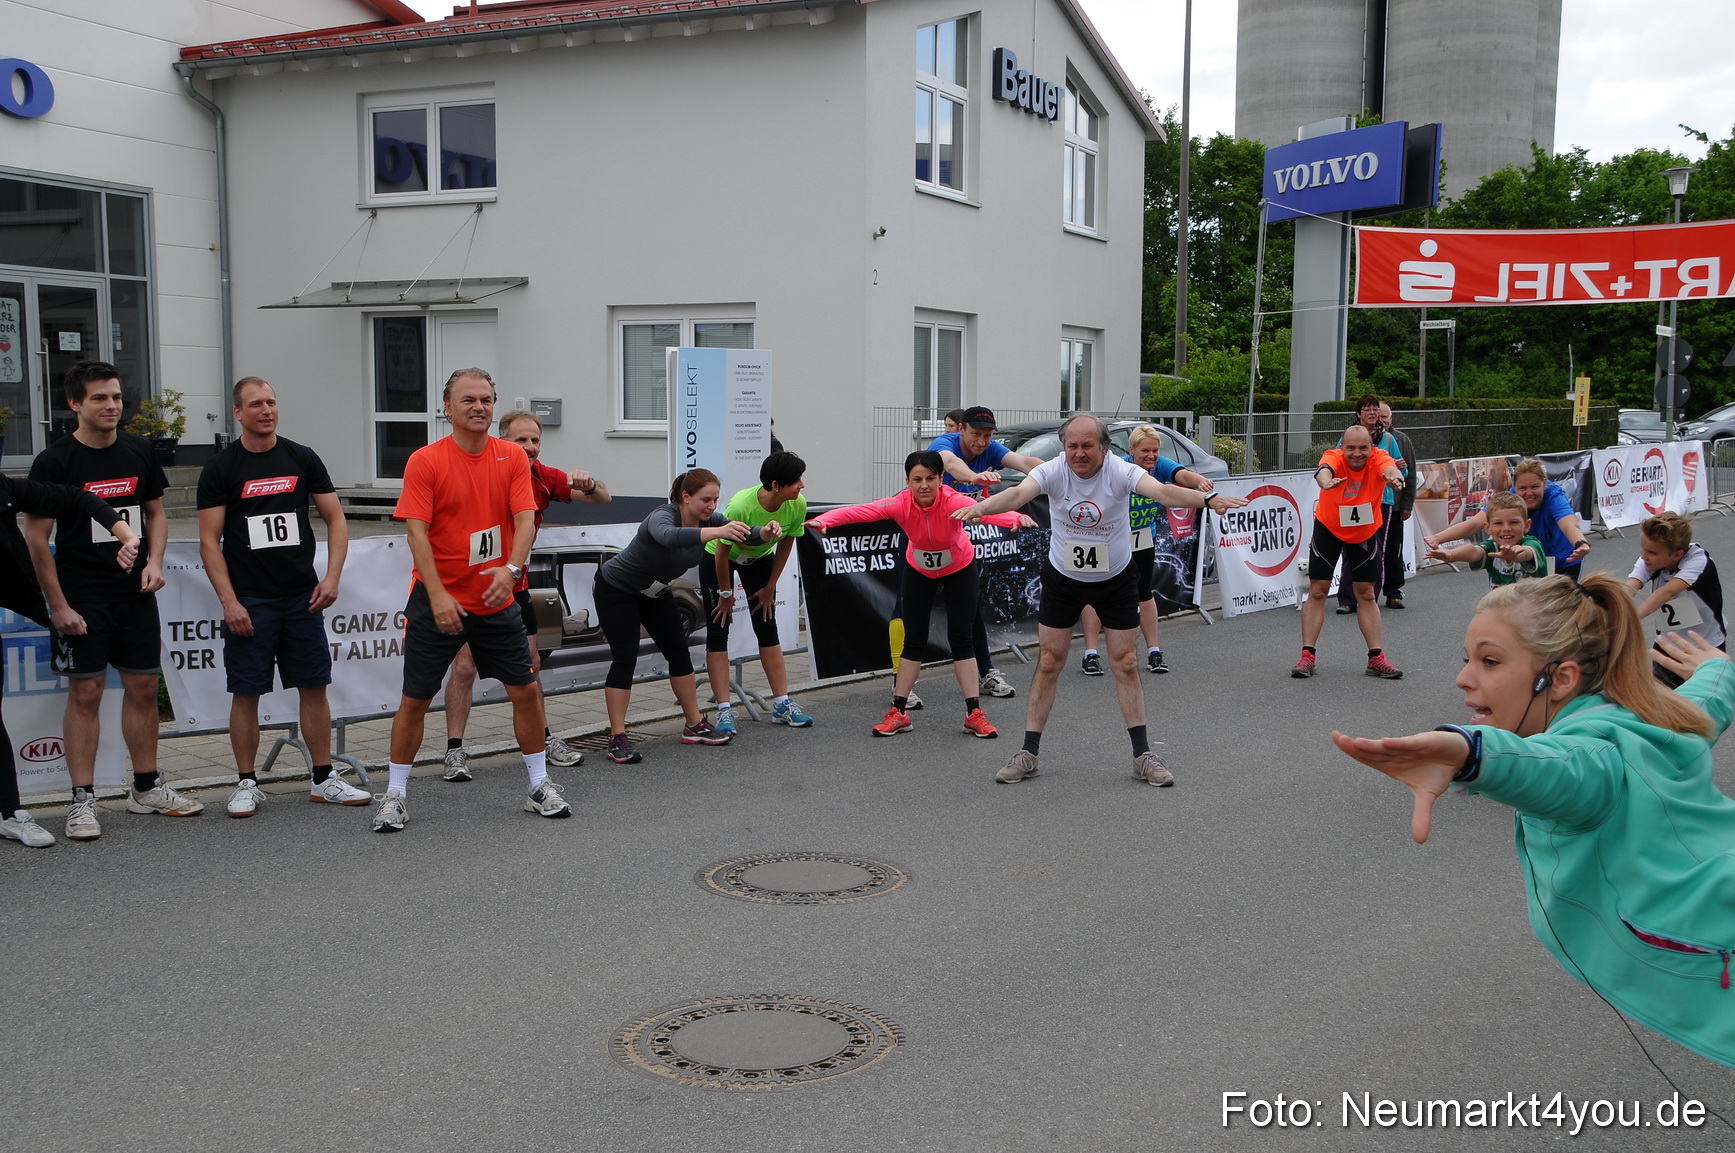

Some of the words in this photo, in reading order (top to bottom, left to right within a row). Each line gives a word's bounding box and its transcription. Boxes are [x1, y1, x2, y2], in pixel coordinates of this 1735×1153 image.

[0, 58, 54, 118] O
[993, 47, 1065, 121] Bauer
[1273, 152, 1379, 194] VOLVO
[873, 269, 878, 286] 2
[686, 363, 698, 469] LVOSELEKT
[1606, 466, 1620, 480] KIA
[88, 481, 133, 496] Franek
[246, 479, 293, 494] Franek
[1131, 495, 1154, 506] ive
[1130, 507, 1157, 518] ove
[1220, 507, 1286, 535] GERHART
[1350, 507, 1360, 523] 4
[262, 515, 288, 542] 16
[964, 525, 1002, 541] SHQAI.
[478, 532, 494, 558] 41
[822, 537, 848, 554] DER
[851, 535, 889, 551] NEUE
[1219, 535, 1252, 548] Autohaus
[1251, 528, 1294, 553] JÄNIG
[825, 557, 866, 575] NEUES
[869, 553, 895, 571] ALS
[922, 551, 943, 568] 37
[1073, 546, 1098, 568] 34
[1263, 587, 1295, 603] Sengenthal
[1661, 603, 1681, 626] 2
[168, 619, 225, 642] TECH
[331, 613, 388, 634] GANZ
[171, 648, 216, 670] DER
[346, 638, 406, 660] ALHA
[29, 741, 63, 758] KIA
[20, 768, 44, 776] Power
